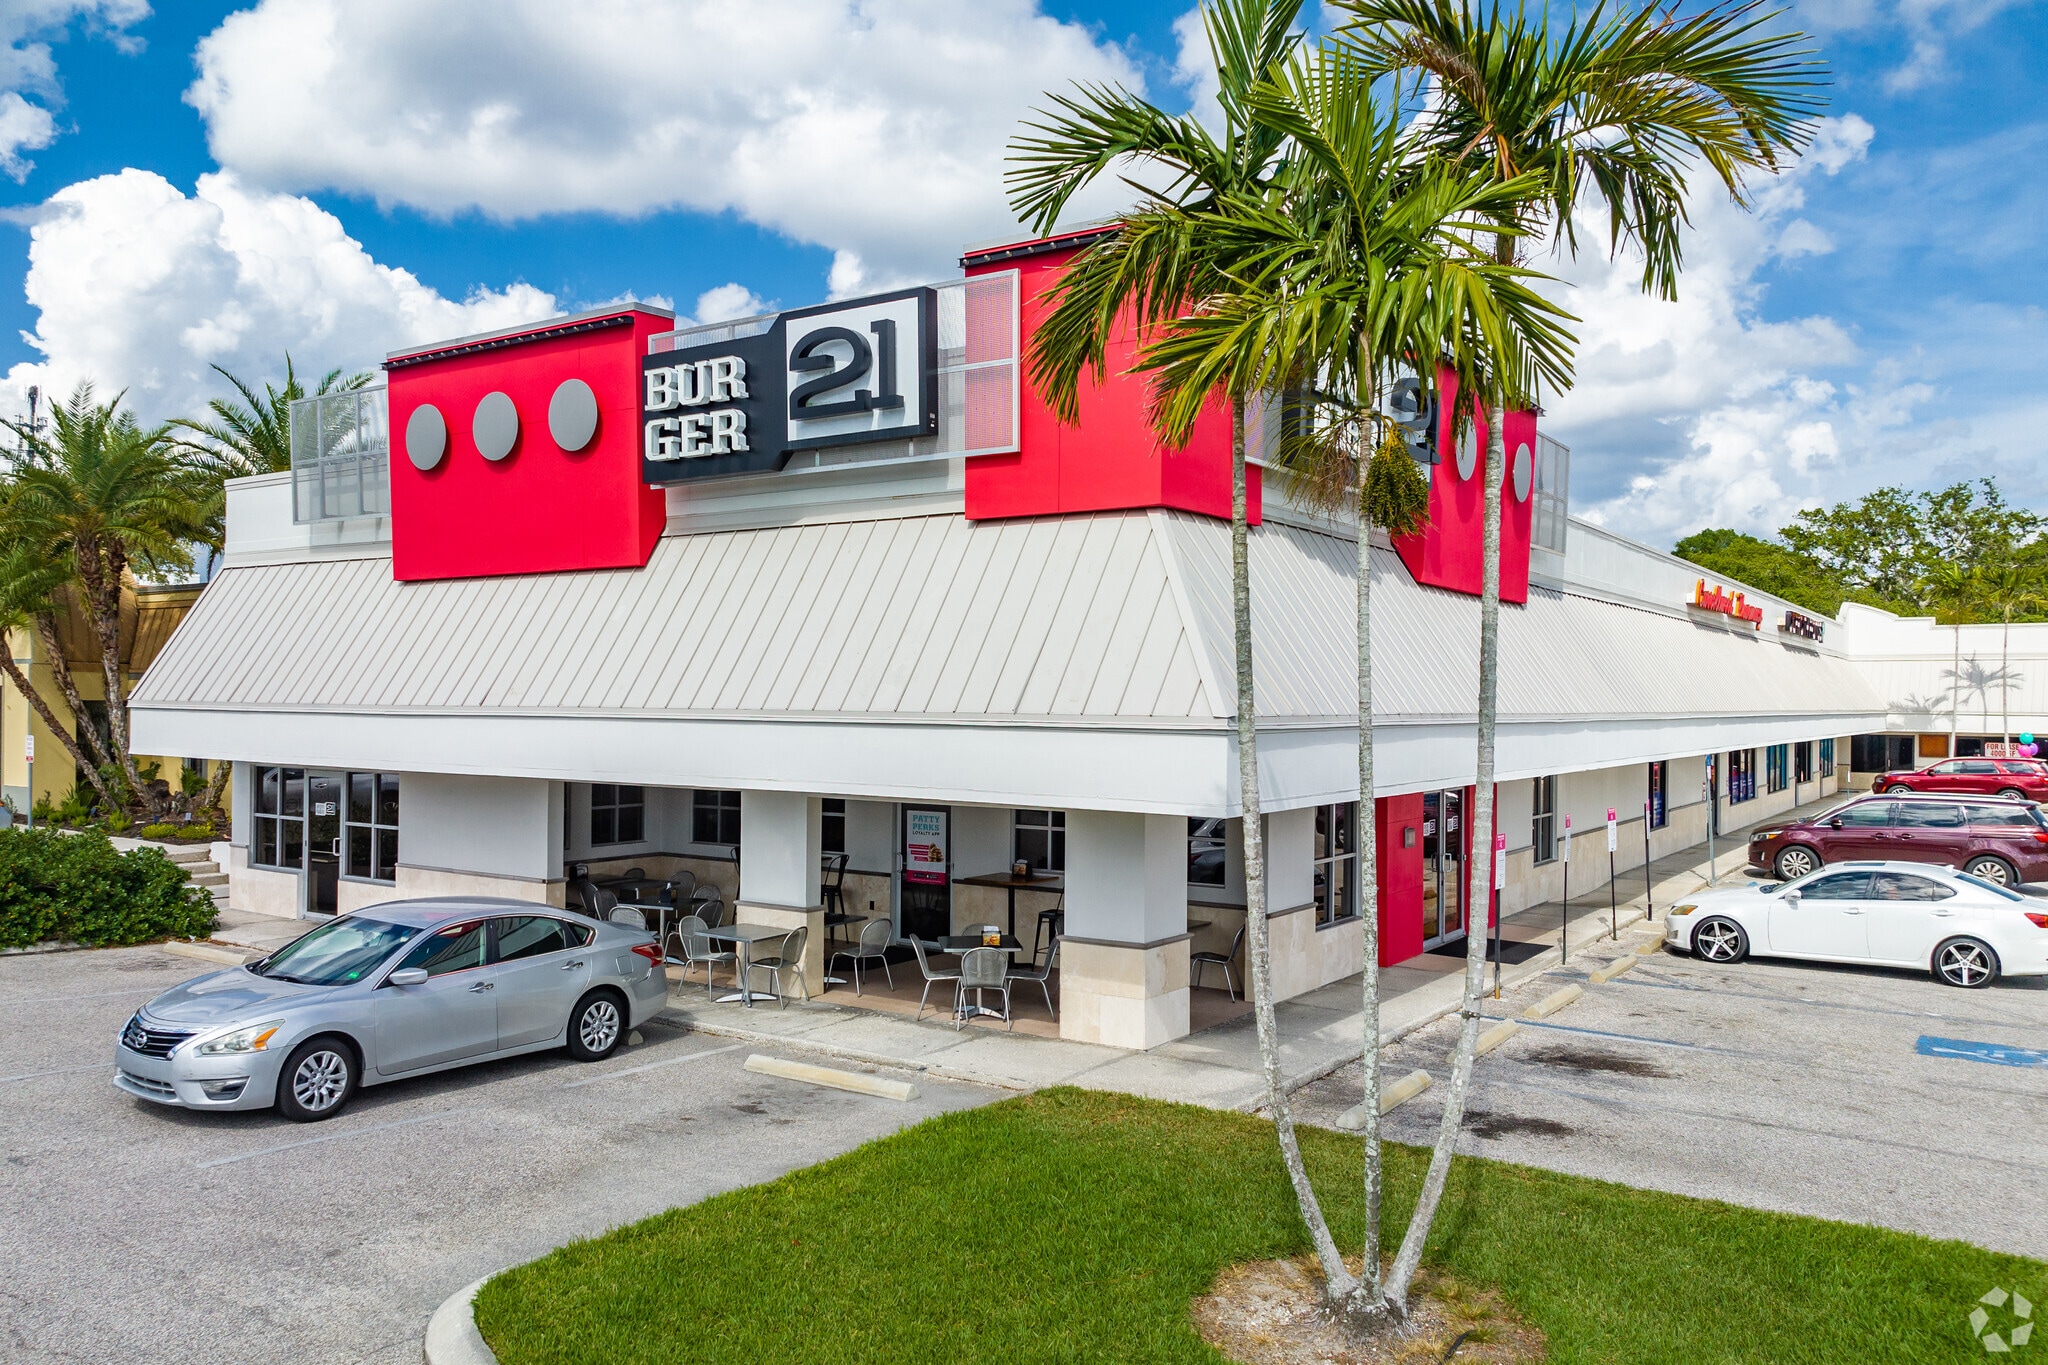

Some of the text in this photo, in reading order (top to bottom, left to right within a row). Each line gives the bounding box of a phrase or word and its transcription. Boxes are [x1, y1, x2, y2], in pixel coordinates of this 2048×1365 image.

[644, 355, 749, 412] BUR
[789, 318, 904, 421] 21
[644, 408, 750, 462] GER
[913, 815, 940, 823] PATTY
[913, 823, 940, 831] PERKS
